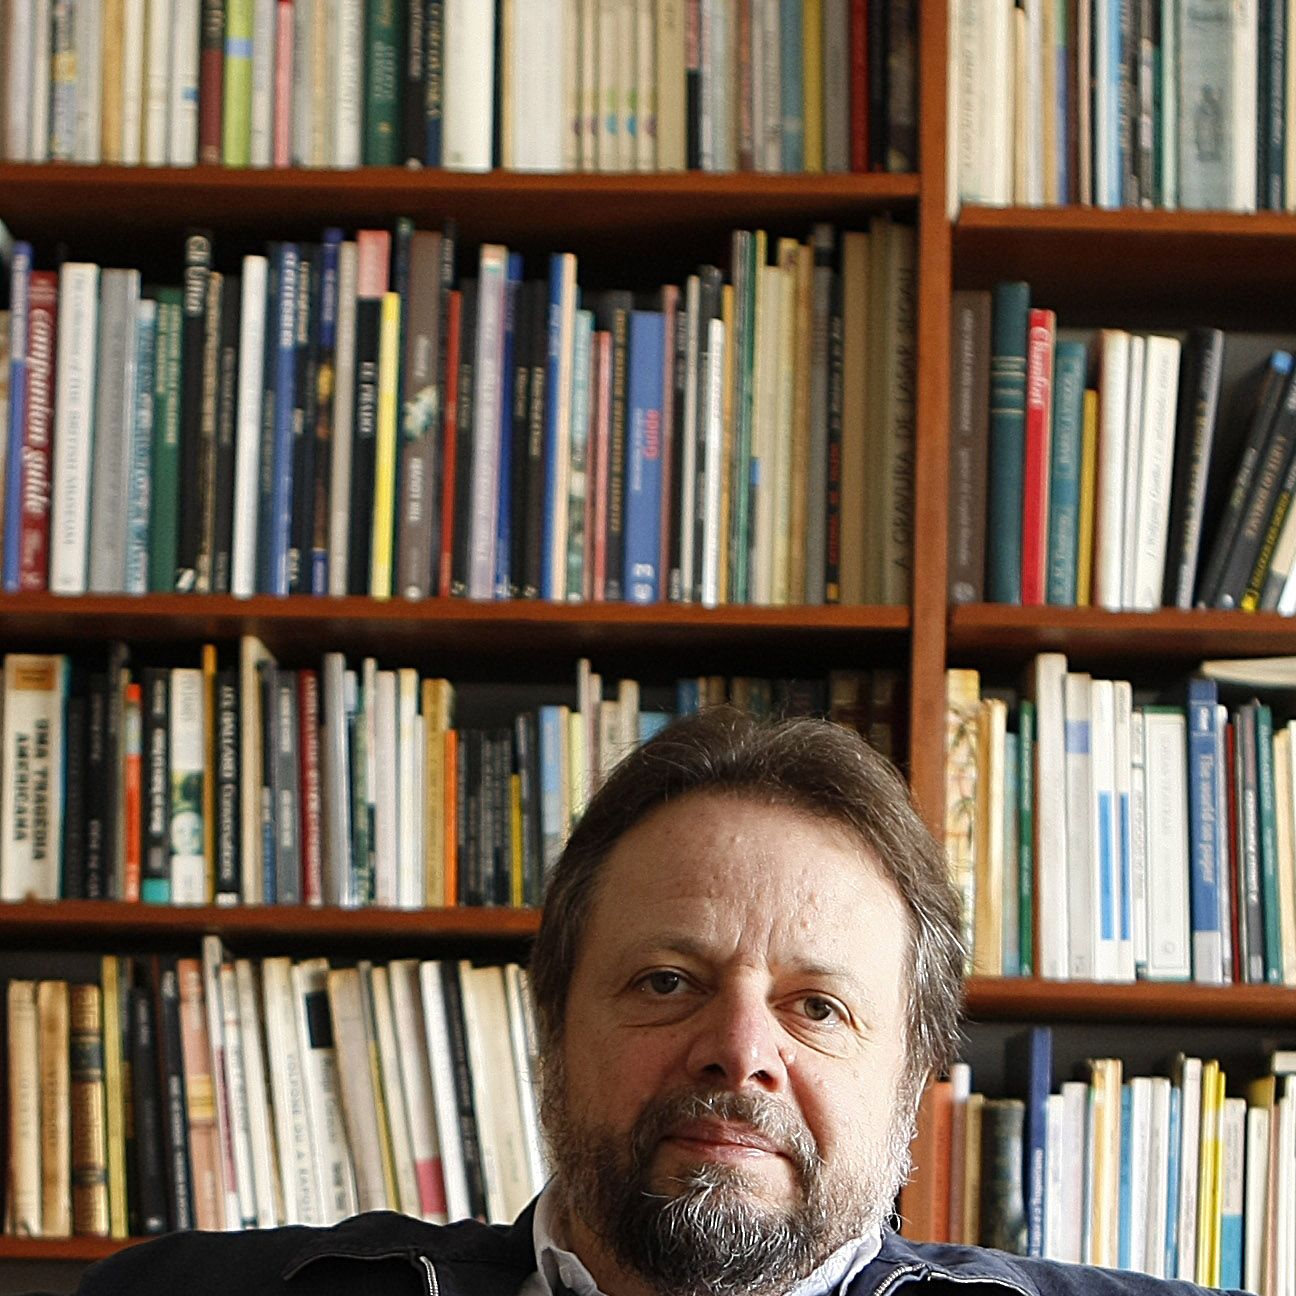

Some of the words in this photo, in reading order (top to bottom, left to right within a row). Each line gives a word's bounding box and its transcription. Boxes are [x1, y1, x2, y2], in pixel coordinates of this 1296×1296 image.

[26, 309, 51, 446] companion
[1028, 326, 1050, 410] Chamfort
[65, 410, 82, 471] BRITISH
[643, 408, 660, 460] Guide
[895, 424, 913, 440] DE
[21, 446, 50, 517] guide
[63, 473, 79, 545] MUSEUM
[892, 451, 913, 545] GRAVURA
[894, 556, 910, 570] A
[35, 718, 50, 759] UMA
[221, 711, 236, 778] BALLARD
[1201, 754, 1215, 778] The
[13, 732, 30, 842] AMERICANA
[1200, 781, 1215, 819] world
[221, 784, 235, 880] Conversations
[1201, 823, 1211, 842] on
[1199, 843, 1215, 884] paper
